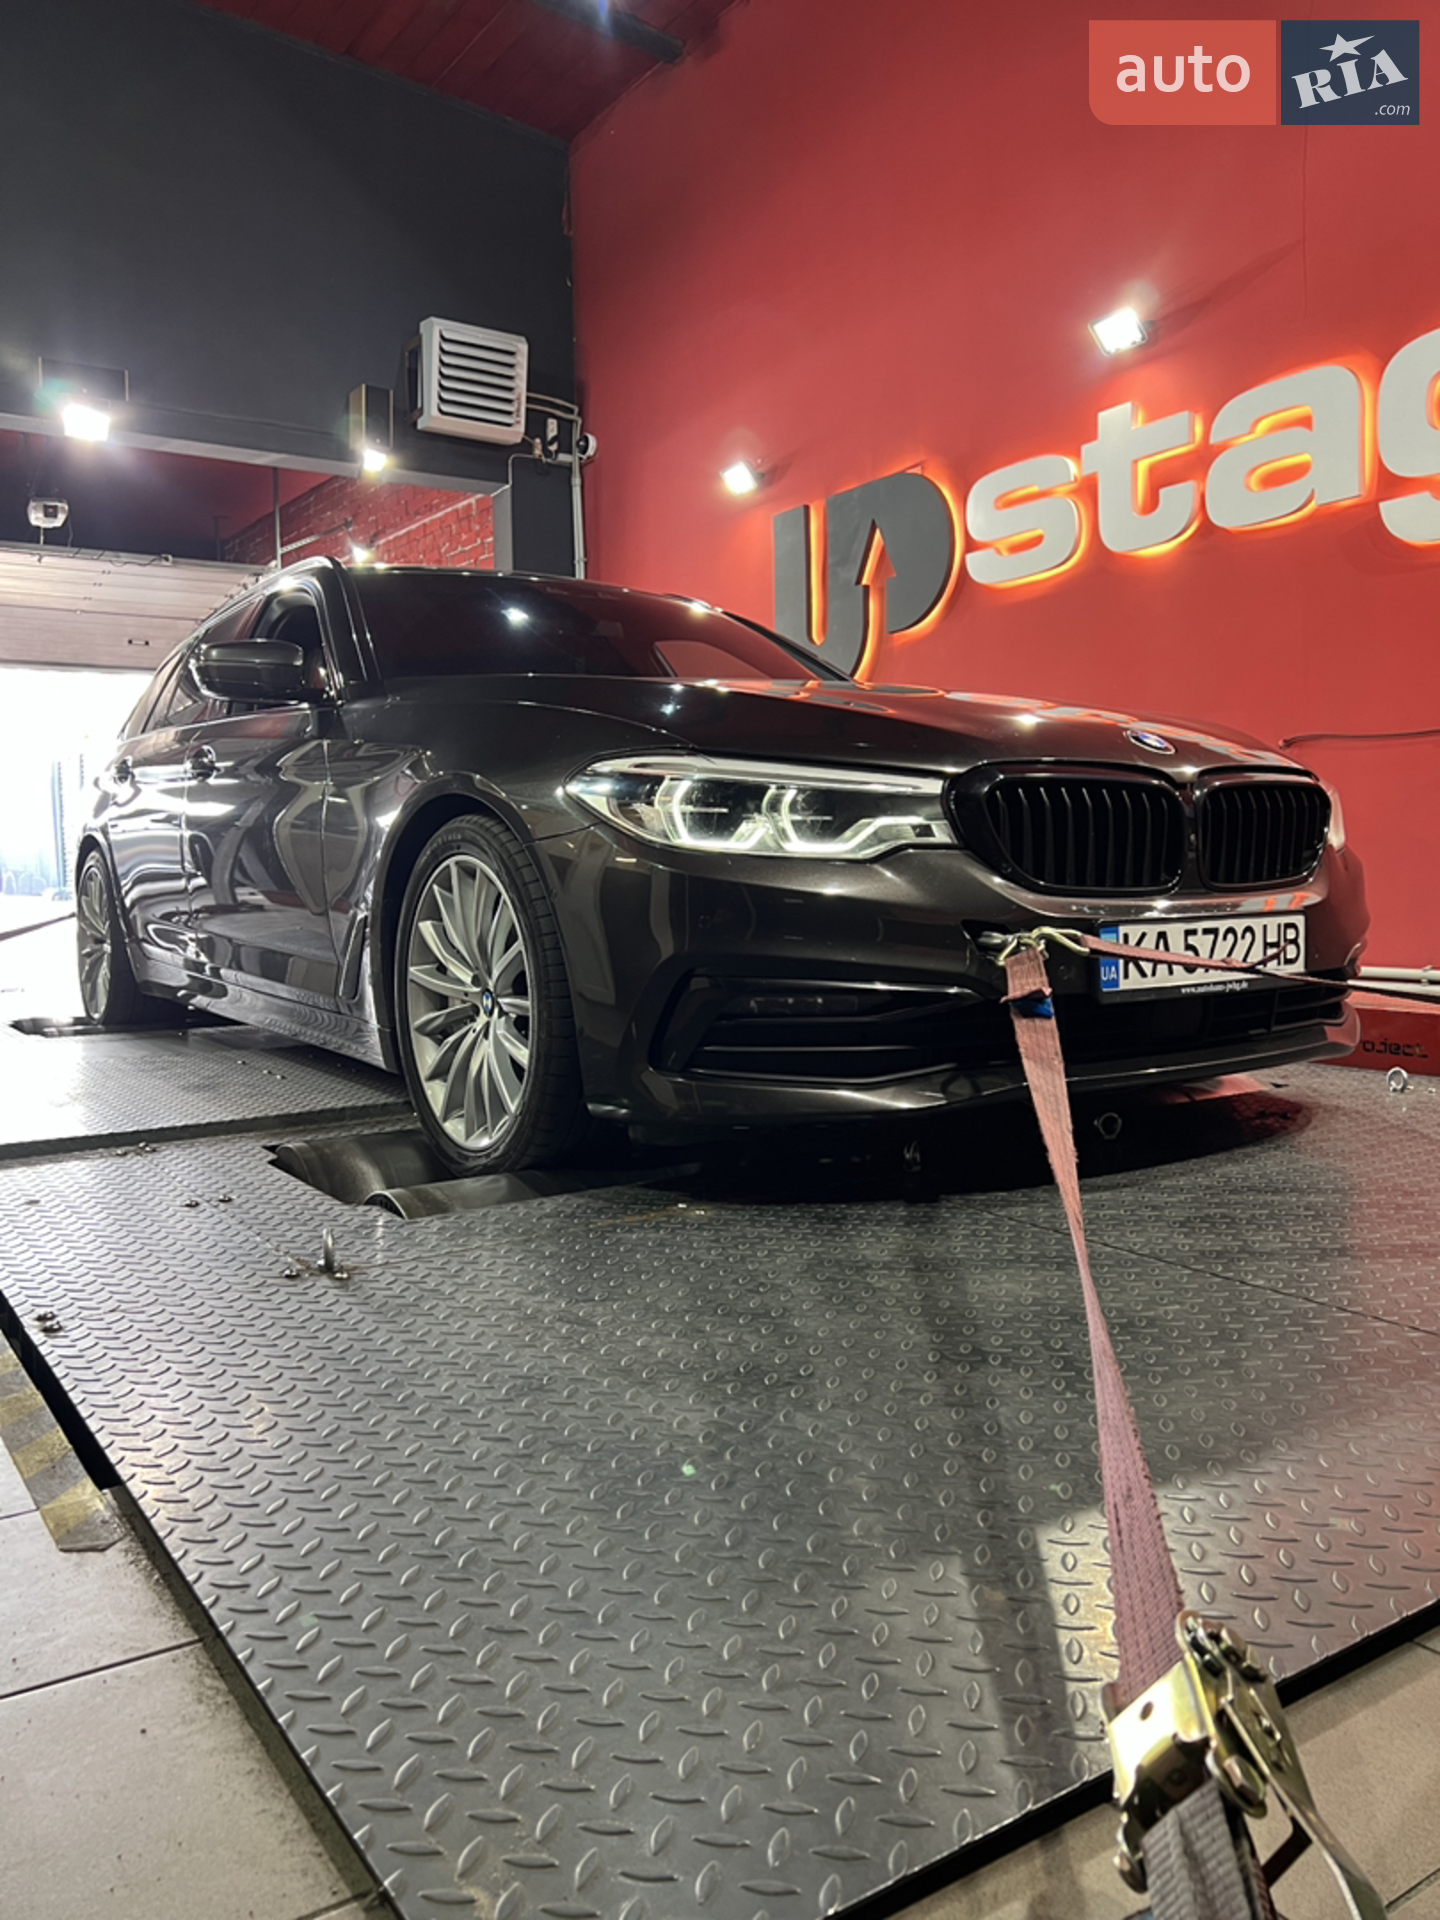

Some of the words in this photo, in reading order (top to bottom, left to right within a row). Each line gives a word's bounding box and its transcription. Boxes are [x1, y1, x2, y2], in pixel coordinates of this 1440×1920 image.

[1122, 931, 1174, 980] KA
[1184, 926, 1256, 974] 5722
[1262, 922, 1300, 968] HB
[1101, 966, 1117, 981] UA
[1360, 1038, 1429, 1059] oject
